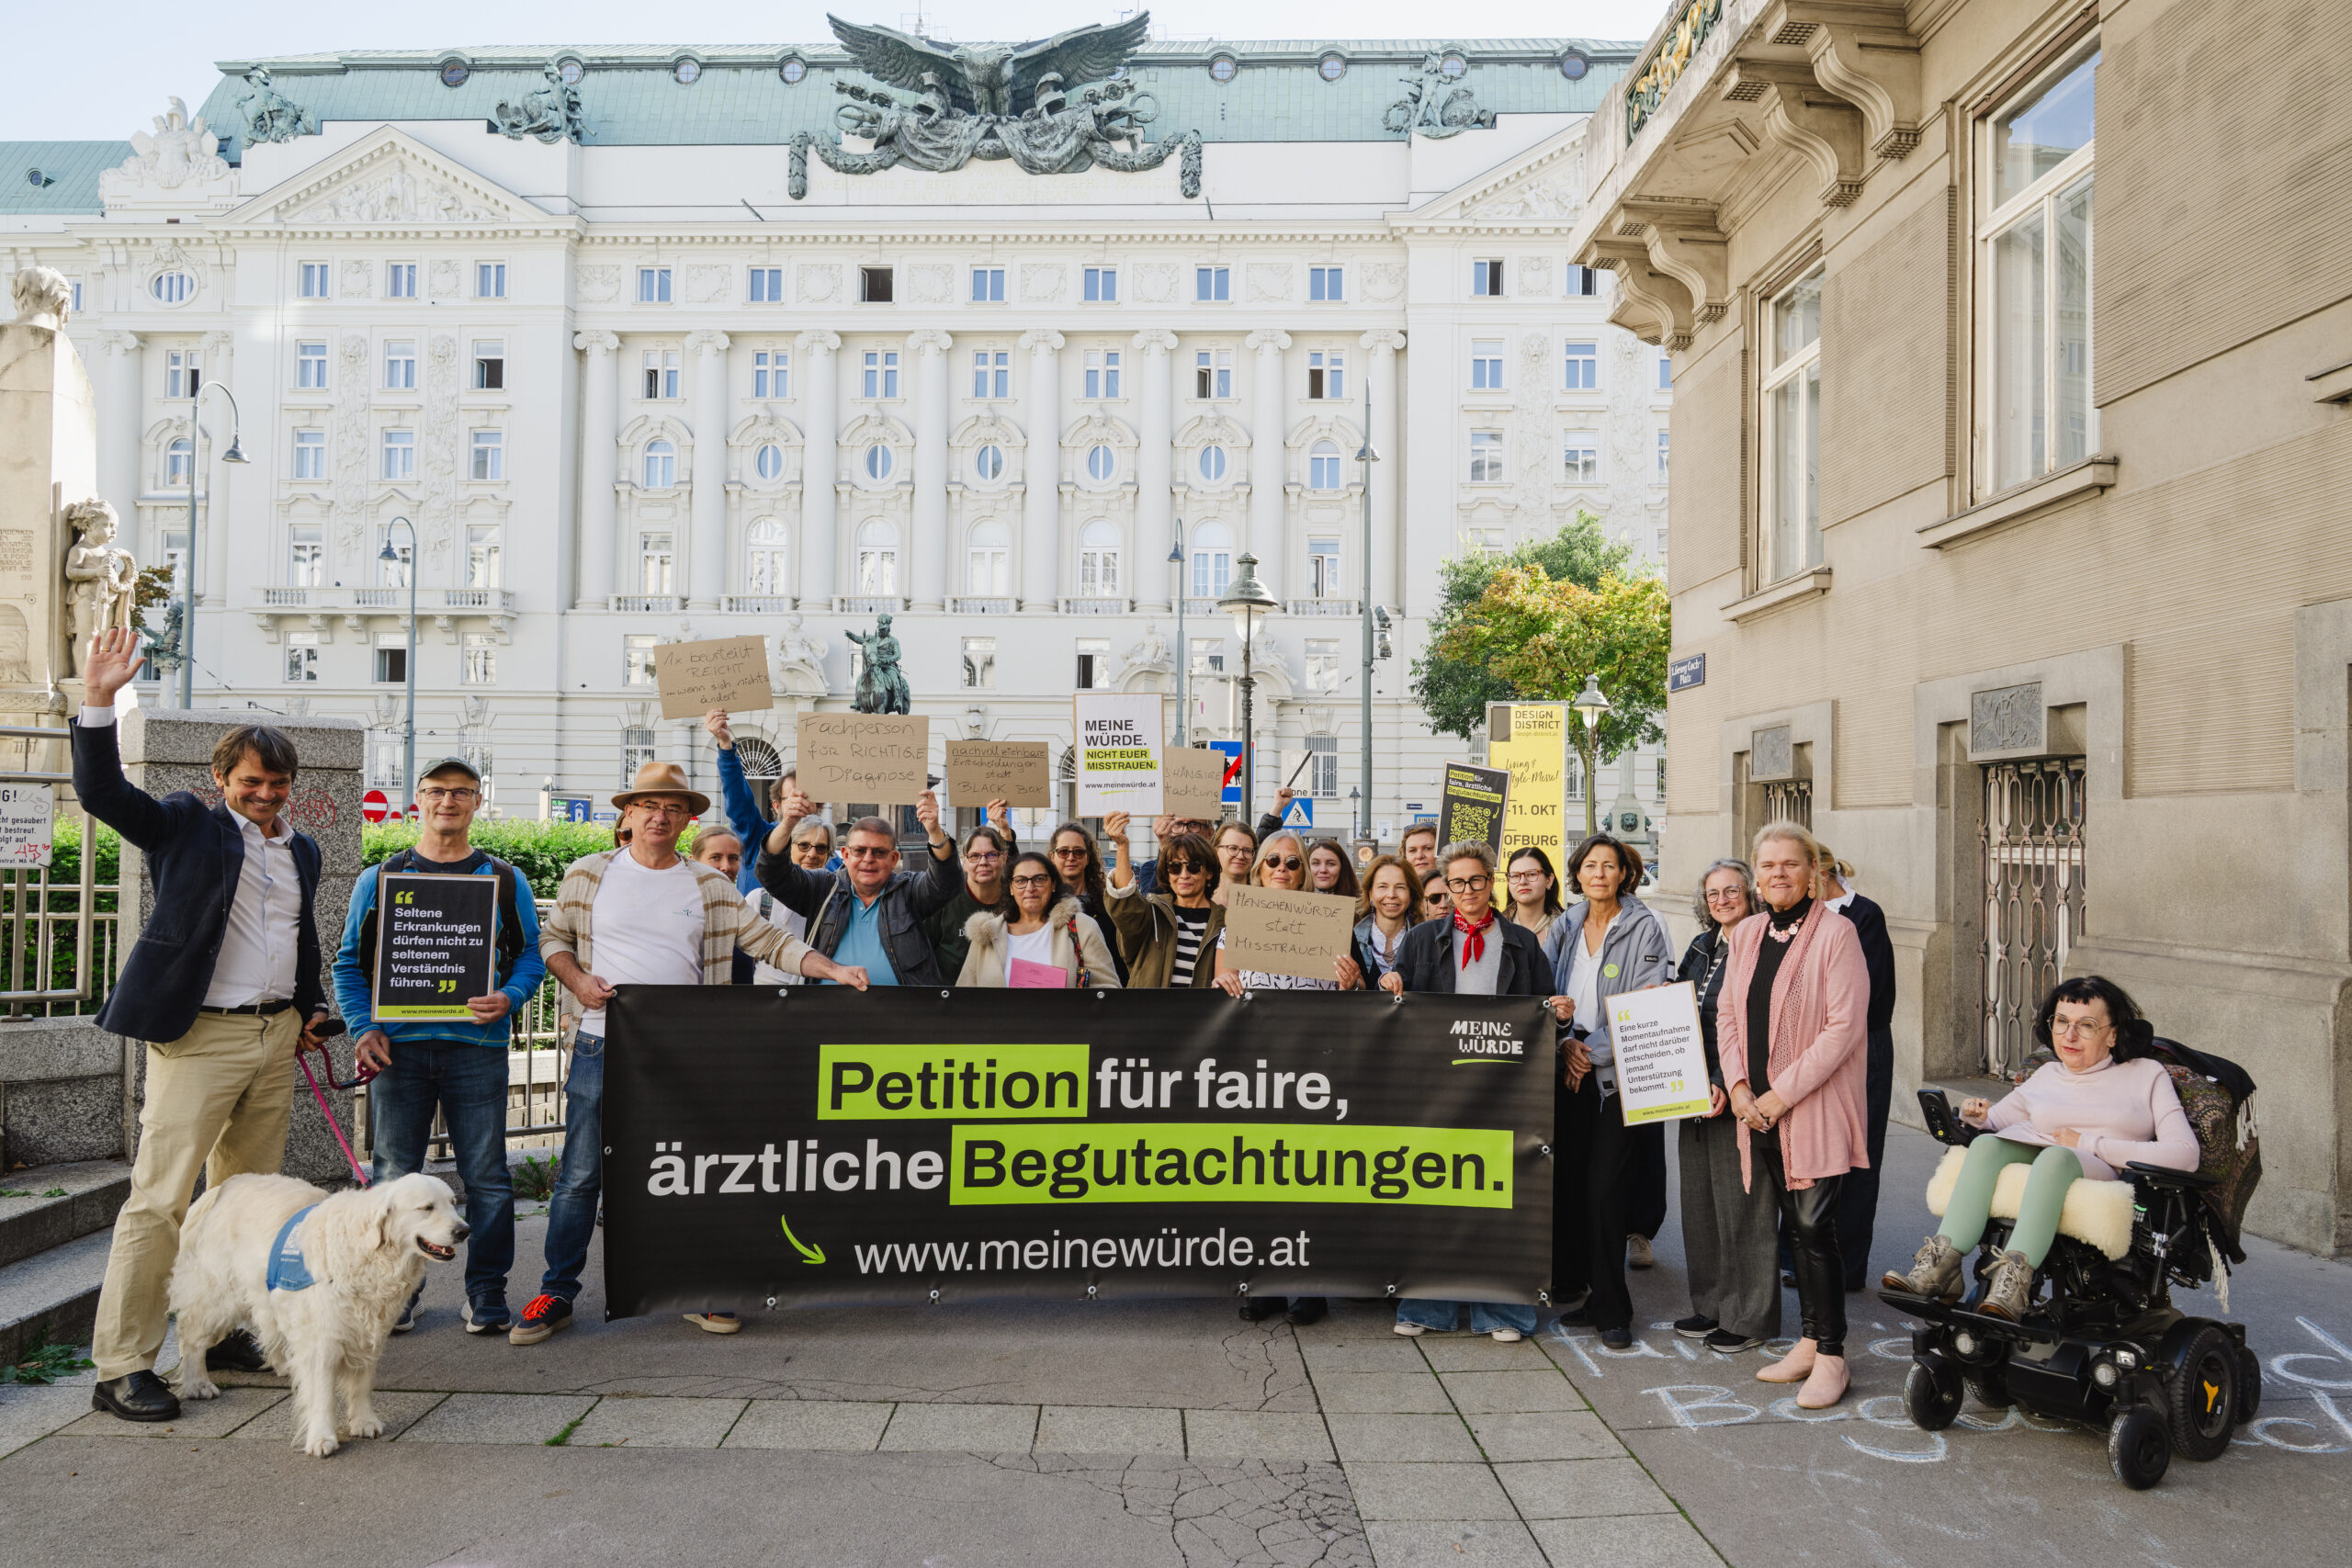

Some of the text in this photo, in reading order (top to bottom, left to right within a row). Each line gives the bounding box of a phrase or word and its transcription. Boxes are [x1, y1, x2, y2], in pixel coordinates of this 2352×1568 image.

[690, 643, 754, 662] beurteilt
[686, 662, 745, 678] REICHT
[711, 680, 731, 691] sich
[737, 671, 770, 686] nichts
[700, 690, 738, 705] ändert
[1515, 710, 1554, 719] DESIGN
[800, 716, 915, 741] Fachperson
[1085, 719, 1134, 731] MEINE
[1515, 720, 1561, 729] DISTRICT
[1085, 732, 1148, 747] WÜRDE.
[850, 743, 927, 760] RICHTIGE
[1087, 750, 1148, 759] NICHT EUER
[952, 758, 1037, 773] Entscheidungen
[1087, 761, 1157, 770] MISSTRAUEN.
[1506, 758, 1530, 773] Living
[820, 765, 917, 790] Diagnose
[1450, 770, 1484, 783] Petition für
[1511, 770, 1559, 788] tyle-Messe!
[957, 781, 1007, 794] BLACK
[1085, 781, 1157, 789] www.meinewürde.at
[1294, 788, 1308, 796] one
[1464, 781, 1493, 793] ärztliche
[0, 790, 17, 803] G!
[1165, 784, 1219, 807] tachtung
[1448, 786, 1502, 803] Begutachtungen.
[1531, 805, 1557, 816] OKT
[1504, 834, 1558, 846] OFBURG
[1236, 890, 1341, 918] MENSCHENWÜRDE
[394, 907, 443, 918] Seltene
[393, 921, 481, 934] Erkrankungen
[1265, 917, 1306, 935] statt
[392, 935, 483, 946] dürfen nicht zu
[1235, 935, 1333, 956] MISSTRAUEN
[391, 949, 450, 960] seltenem
[390, 963, 466, 974] Verständnis
[390, 976, 435, 987] führen.
[1449, 1020, 1512, 1037] MEINE
[1619, 1020, 1659, 1033] Eine kurze
[1621, 1024, 1691, 1043] Momentaufnahme
[1459, 1035, 1523, 1055] WÜRDE
[1623, 1035, 1690, 1054] darf nicht darüber
[1624, 1047, 1686, 1065] entscheiden, ob
[1625, 1062, 1654, 1076] jemand
[1627, 1068, 1683, 1085] Unterstützung
[830, 1057, 1350, 1121] Petition für faire,
[1629, 1083, 1668, 1095] bekommt.
[647, 1135, 1505, 1200] ärztliche Begutachtungen.
[854, 1226, 1311, 1274] www.meinewürde.at
